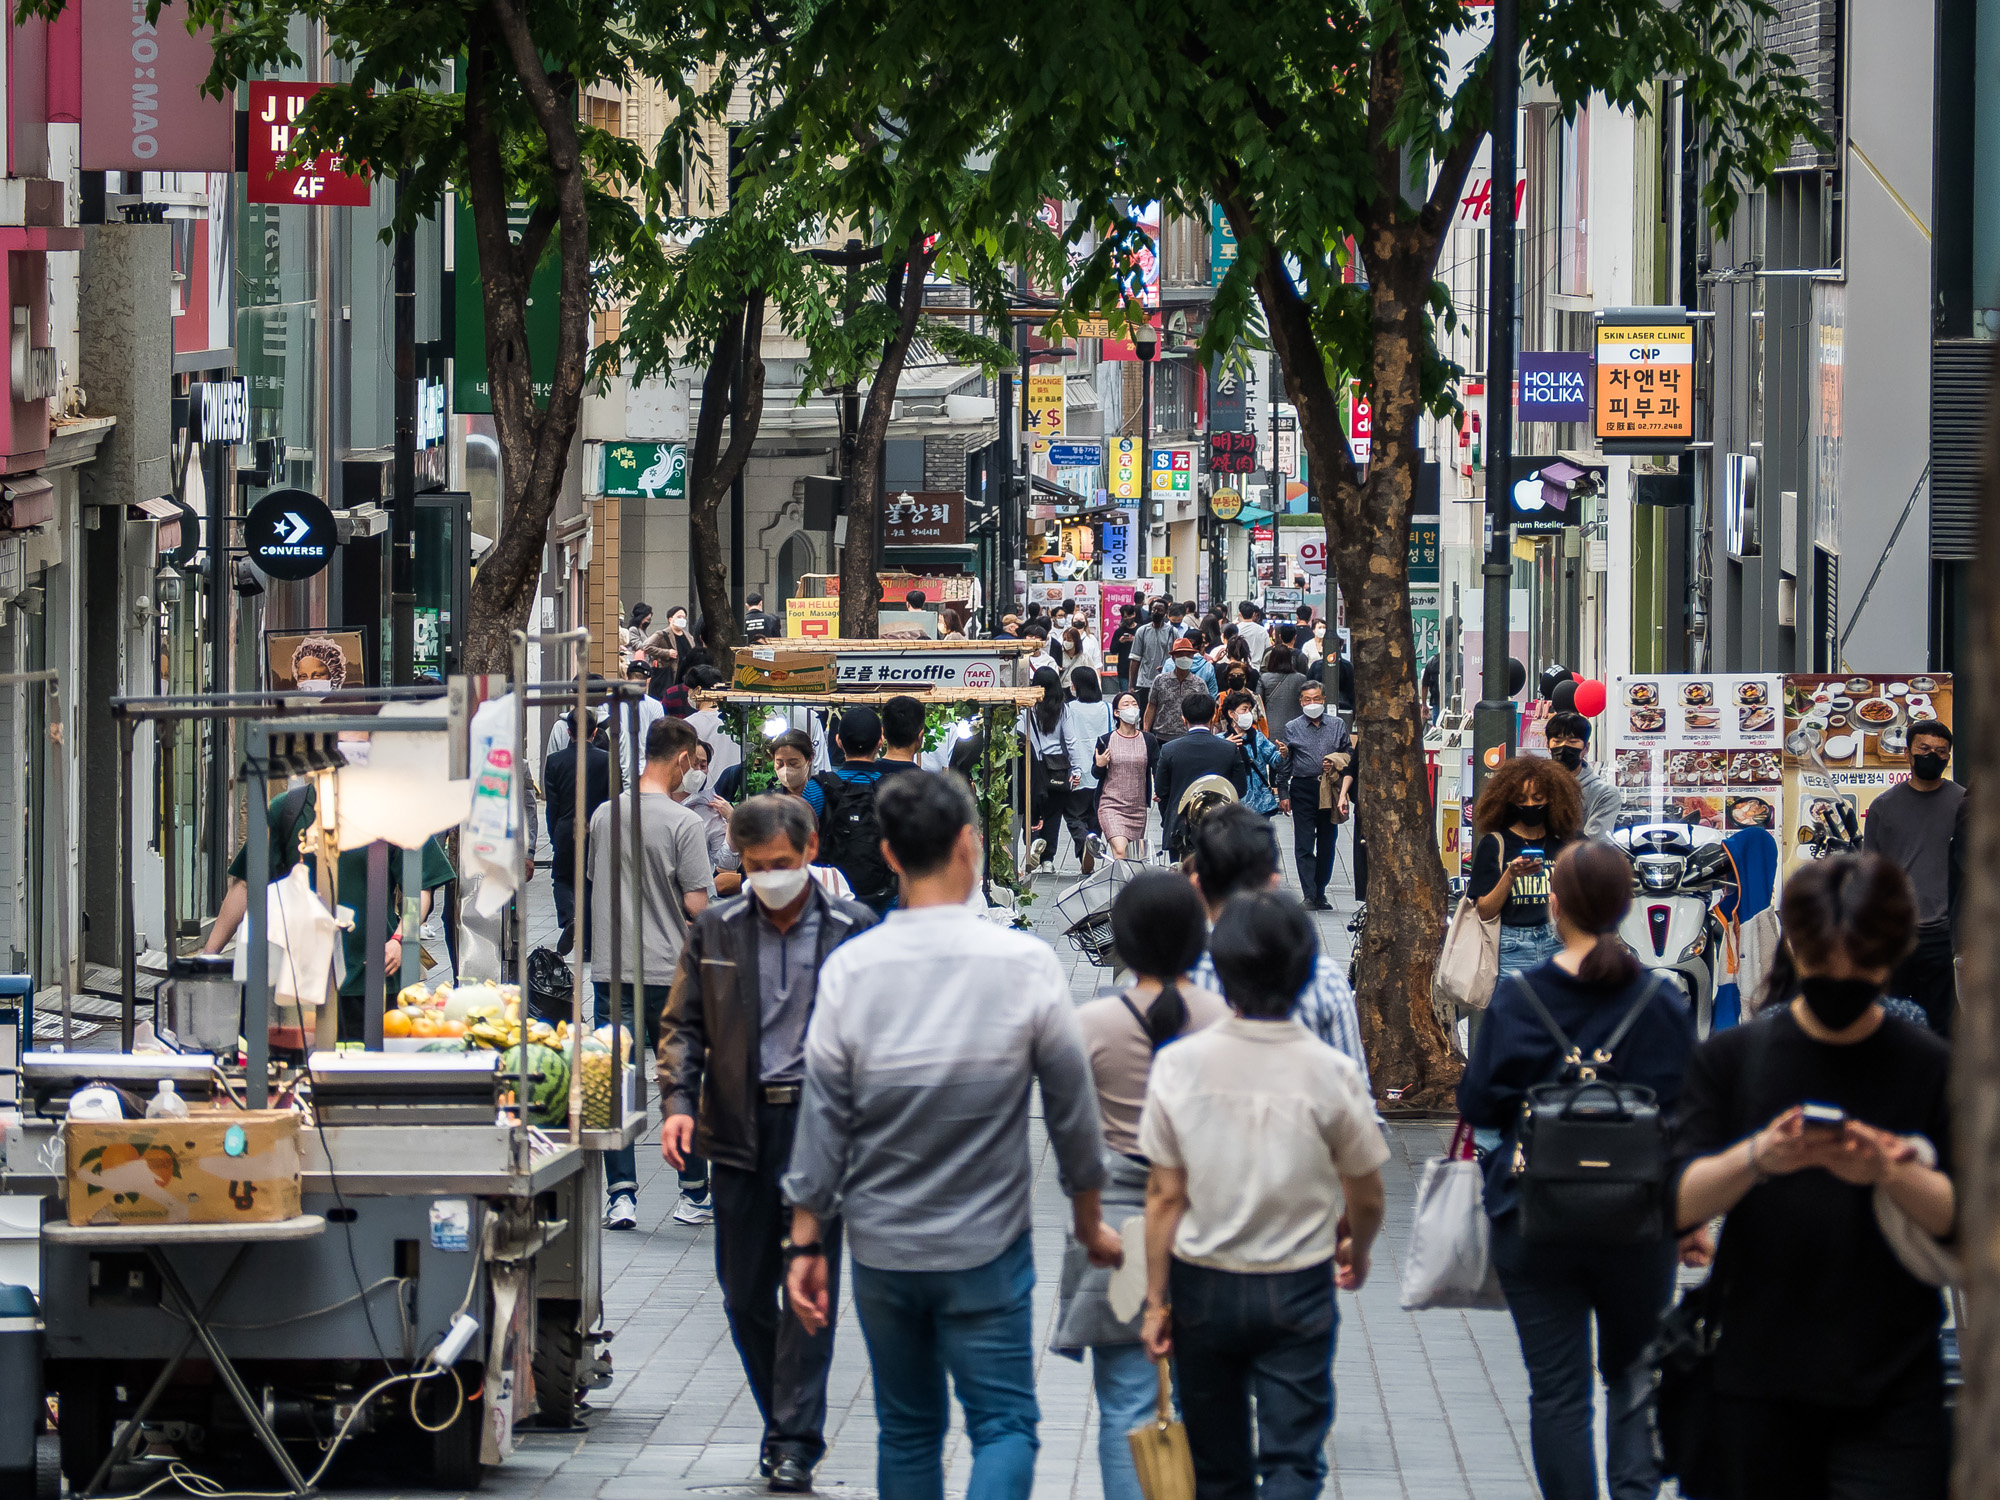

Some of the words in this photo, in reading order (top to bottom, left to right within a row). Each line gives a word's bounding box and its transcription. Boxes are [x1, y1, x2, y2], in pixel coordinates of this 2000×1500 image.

[292, 176, 325, 199] 4F
[1461, 179, 1526, 222] H&
[1629, 348, 1661, 360] CNP
[1525, 372, 1584, 387] HOLIKA
[1609, 369, 1681, 393] 차앤박
[1525, 387, 1584, 402] HOLIKA
[202, 382, 242, 444] CONVERSE
[1609, 398, 1681, 419] 피부과
[1047, 408, 1061, 428] $
[1211, 432, 1256, 452] 明洞
[1156, 453, 1170, 468] $
[1175, 454, 1188, 468] 元
[1155, 473, 1168, 488] €
[1175, 473, 1188, 488] ¥
[665, 488, 683, 496] Hair
[1213, 496, 1240, 508] 부동산
[1534, 521, 1564, 529] Reseller
[259, 546, 324, 555] CONVERSE
[1410, 596, 1437, 606] おかゆ
[878, 665, 956, 681] #croffle
[966, 670, 992, 678] TAKE
[1512, 897, 1529, 905] THE
